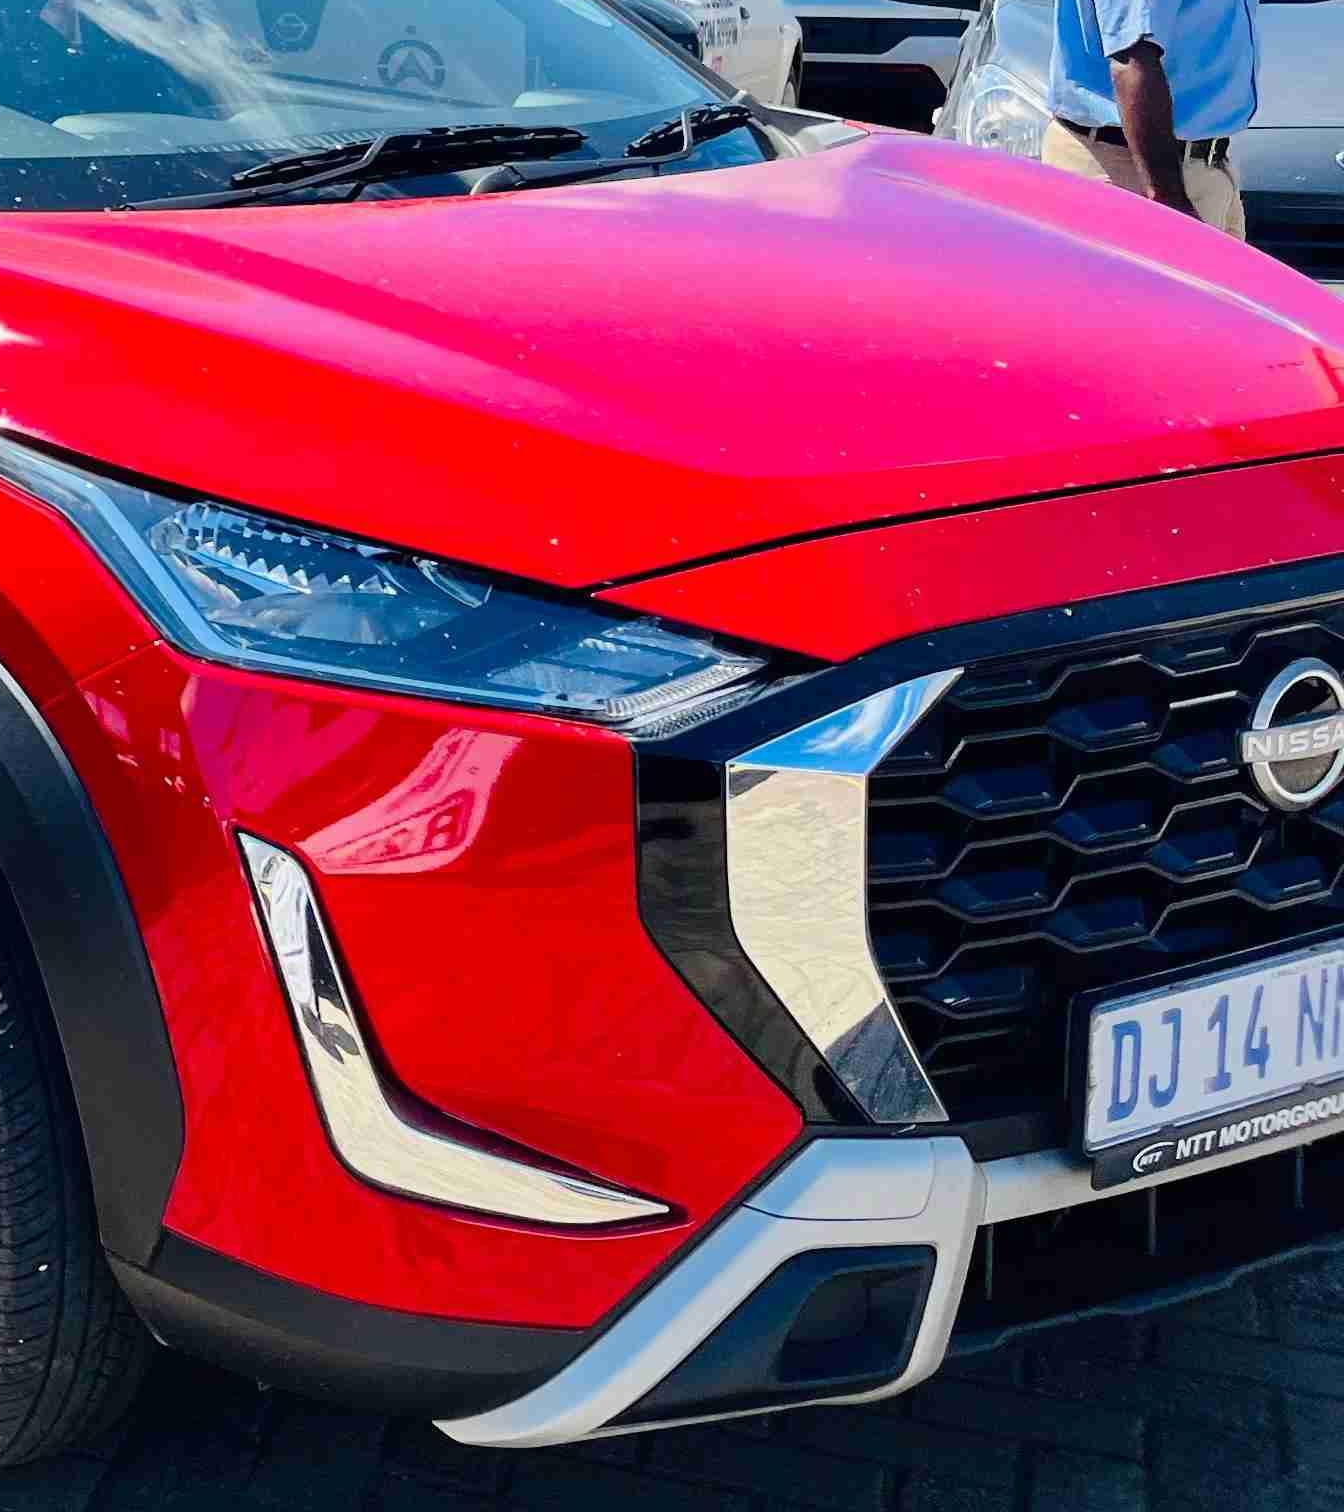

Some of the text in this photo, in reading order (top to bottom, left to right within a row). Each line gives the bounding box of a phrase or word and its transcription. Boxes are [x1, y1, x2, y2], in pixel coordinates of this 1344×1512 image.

[1107, 1008, 1183, 1124] DJ
[1205, 984, 1271, 1097] 14
[1176, 1130, 1217, 1160] NTT
